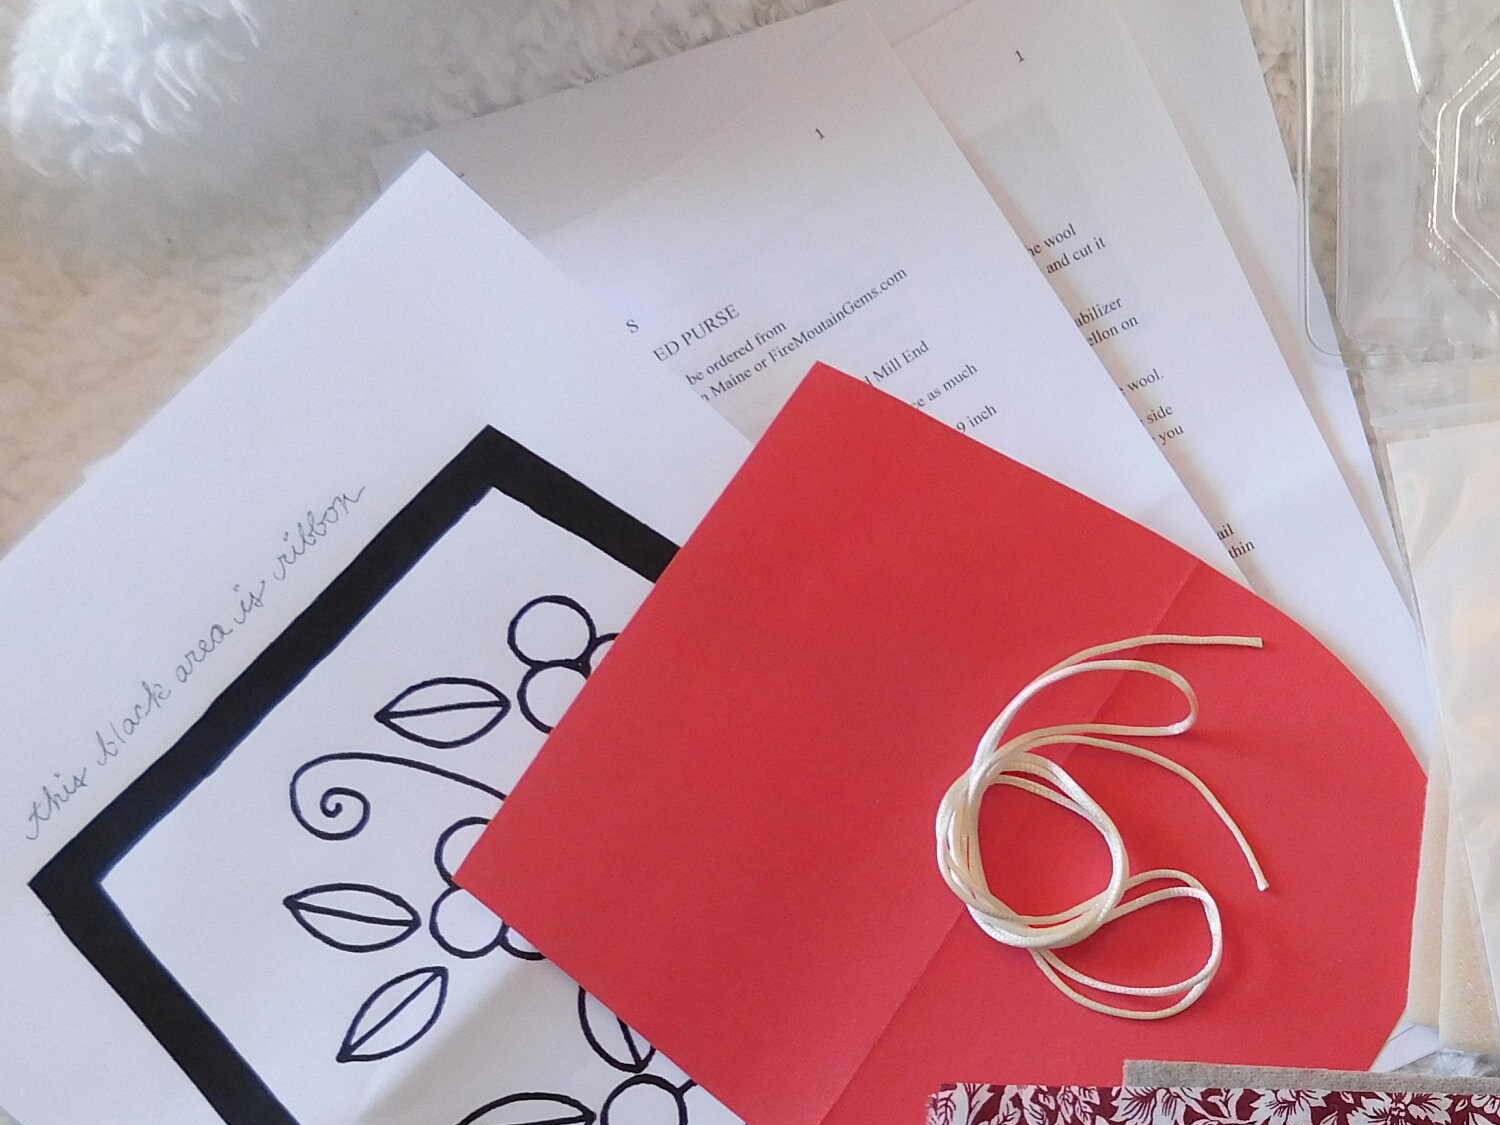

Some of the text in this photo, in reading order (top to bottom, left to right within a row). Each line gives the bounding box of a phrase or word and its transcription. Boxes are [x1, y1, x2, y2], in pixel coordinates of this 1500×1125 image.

[1043, 223, 1076, 248] wool
[1046, 236, 1106, 274] and cut it
[681, 304, 740, 346] PURSE
[709, 368, 752, 397] Maine
[754, 358, 767, 372] or
[768, 268, 908, 363] FireMoutainGems.com
[1121, 316, 1139, 330] on
[685, 321, 787, 385] be ordered from
[873, 357, 902, 382] Mill
[902, 340, 930, 364] End
[927, 388, 941, 402] as
[943, 364, 978, 391] much
[1127, 368, 1165, 392] wool.
[967, 405, 997, 428] inch
[1146, 404, 1173, 424] side
[1158, 425, 1184, 446] you
[26, 486, 366, 841] this black area is ribbon
